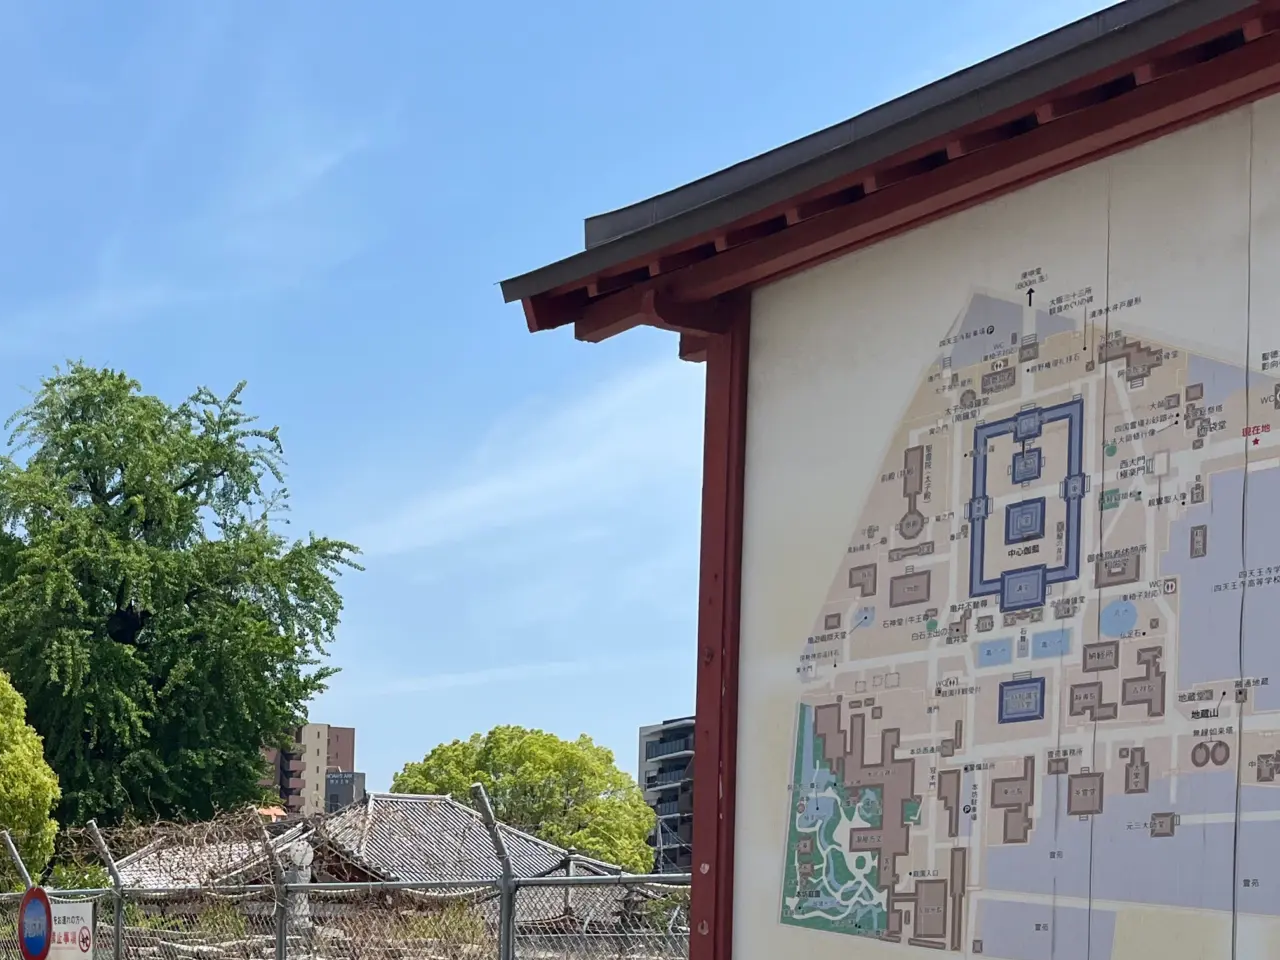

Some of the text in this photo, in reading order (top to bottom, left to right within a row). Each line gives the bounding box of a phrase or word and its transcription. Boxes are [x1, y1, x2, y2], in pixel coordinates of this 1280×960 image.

[1049, 287, 1092, 307] 大阪三十三所
[1261, 348, 1280, 362] 聖徳
[1261, 358, 1280, 371] 影向
[1260, 395, 1275, 404] WC
[1242, 423, 1271, 438] 現在地
[1007, 544, 1040, 557] 中心伽藍
[1149, 580, 1162, 588] WC
[1191, 708, 1219, 719] 地蔵山
